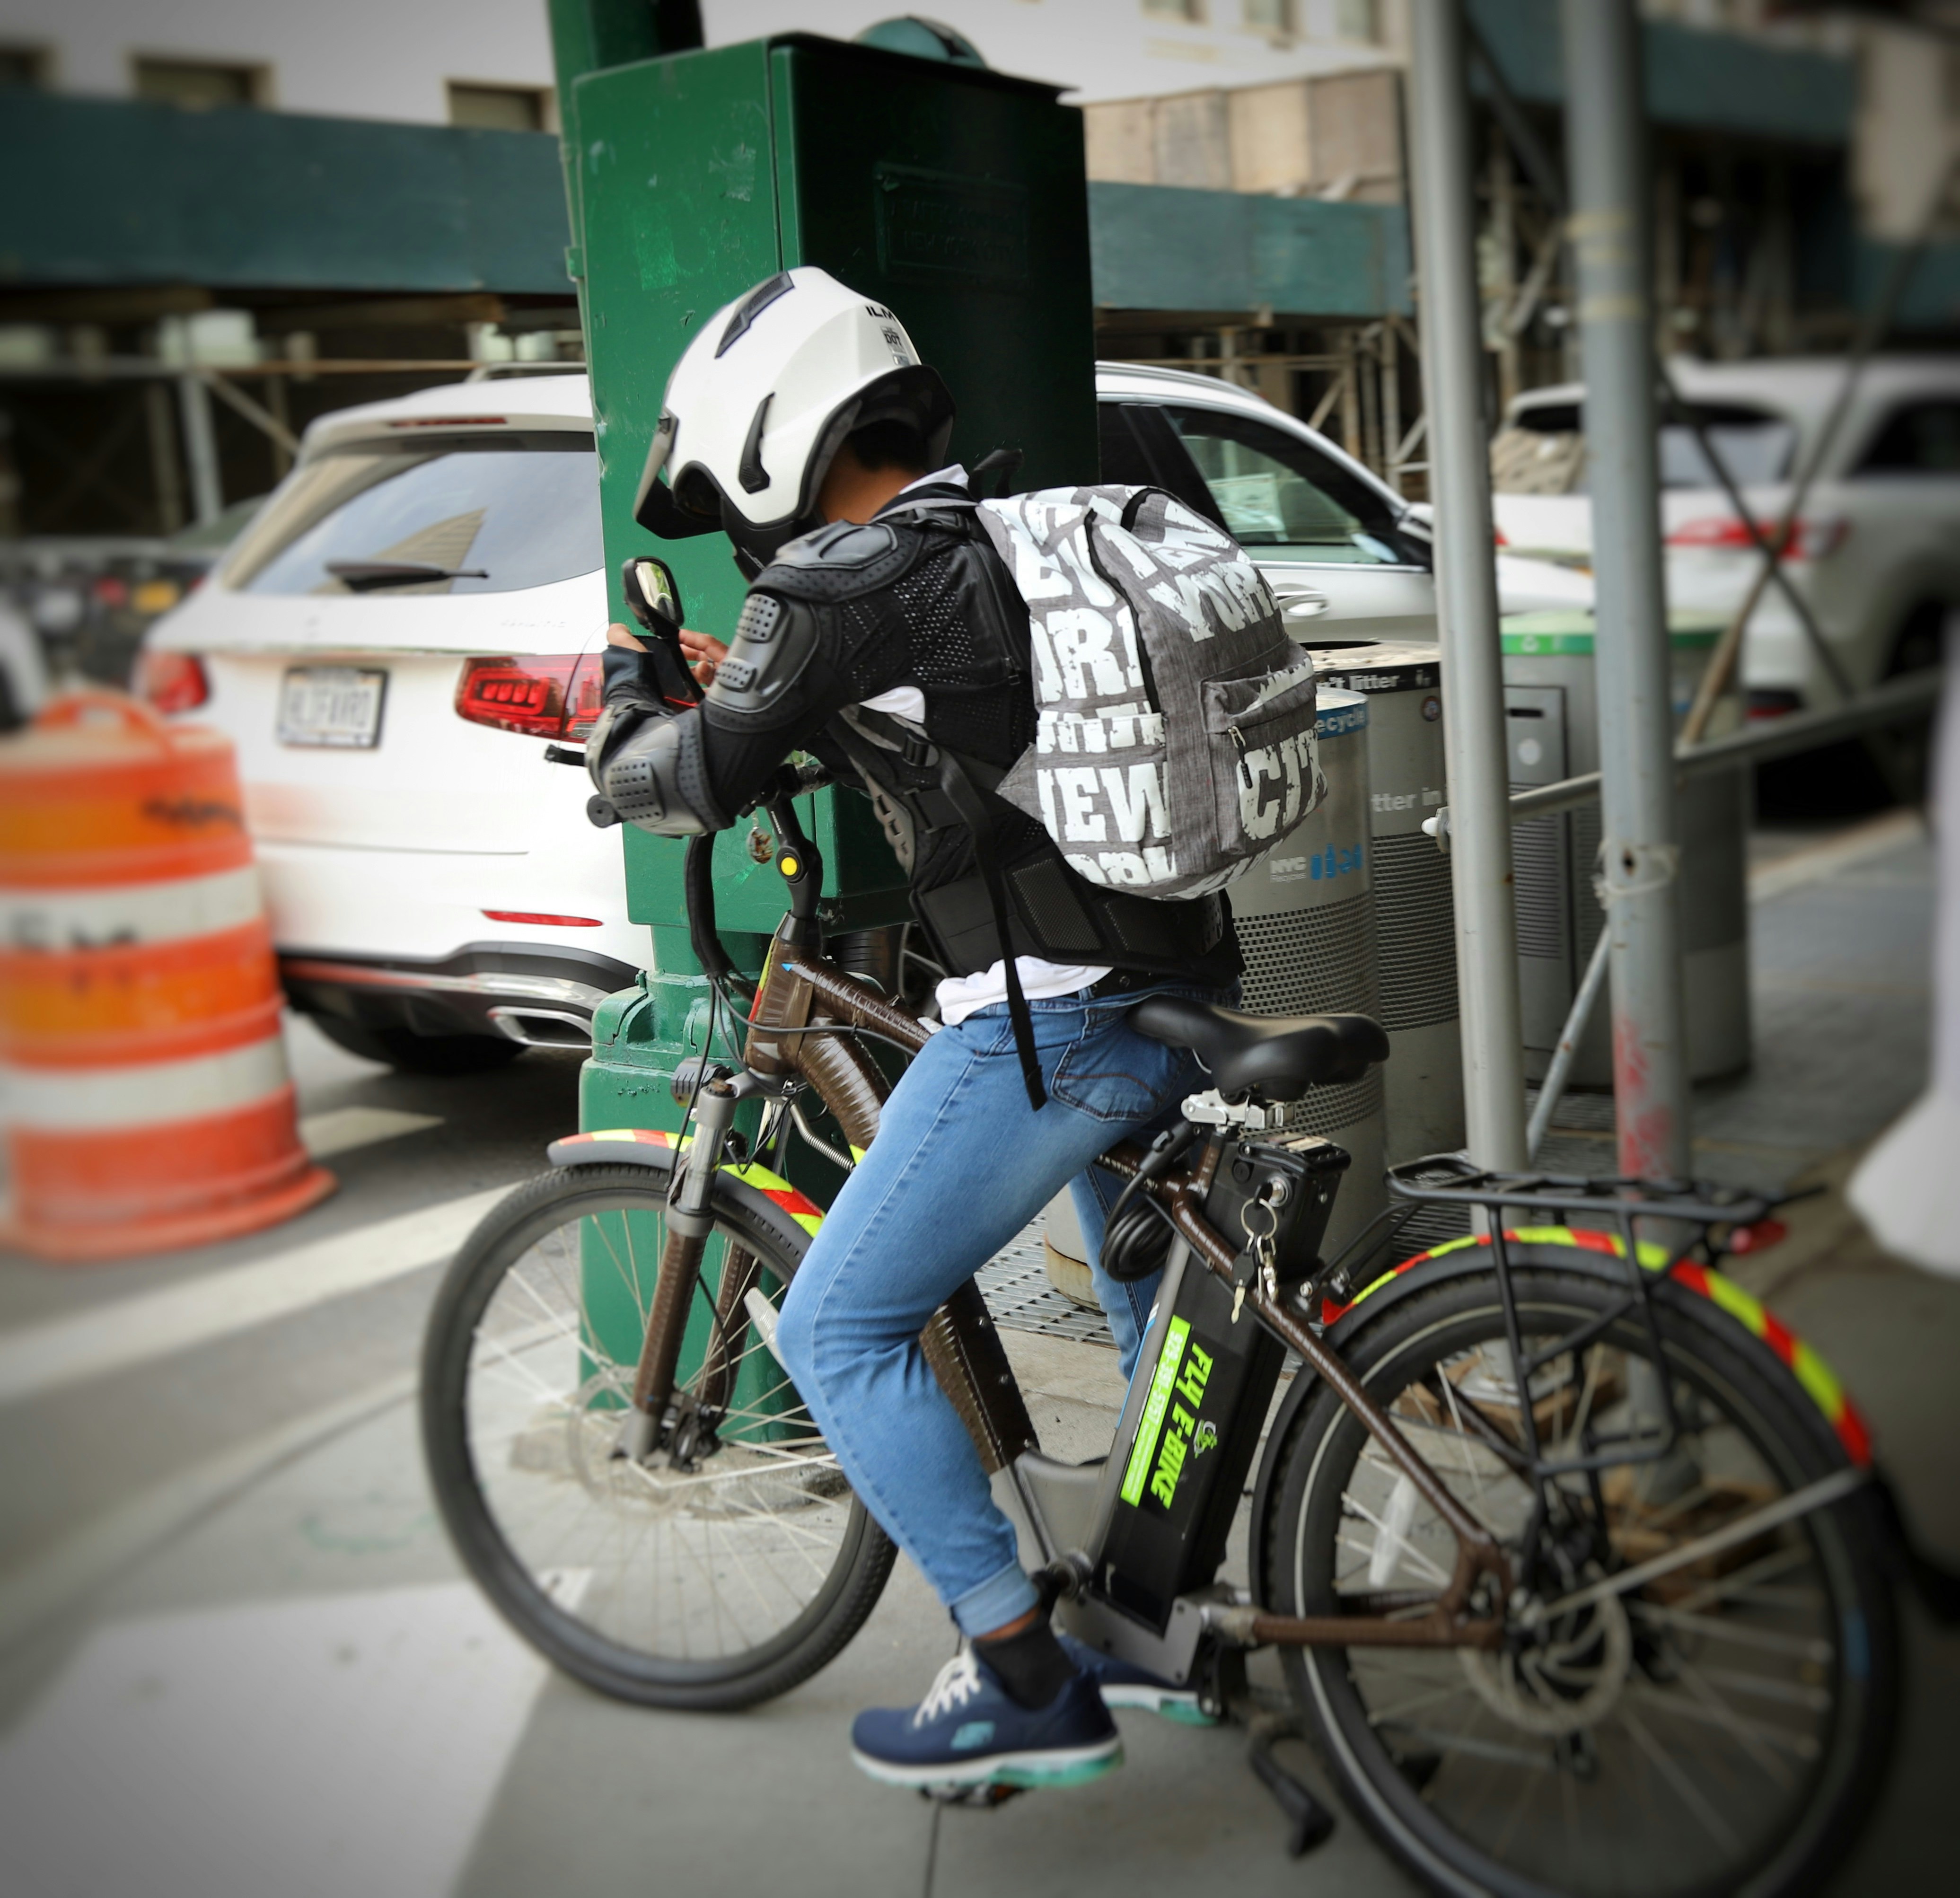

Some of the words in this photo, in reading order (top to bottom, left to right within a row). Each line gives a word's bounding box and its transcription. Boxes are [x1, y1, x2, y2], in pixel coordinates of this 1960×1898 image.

[865, 306, 897, 322] ILM
[884, 333, 902, 346] DOT
[1146, 561, 1278, 642] YOR
[1349, 675, 1400, 690] litter
[1315, 708, 1366, 732] ecycle
[1236, 728, 1328, 840] CIT
[1372, 793, 1416, 812] tter
[1422, 787, 1442, 806] in
[1270, 856, 1306, 874] NYC
[1175, 1342, 1214, 1410] FLY
[1150, 1401, 1196, 1510] E-BIKE
